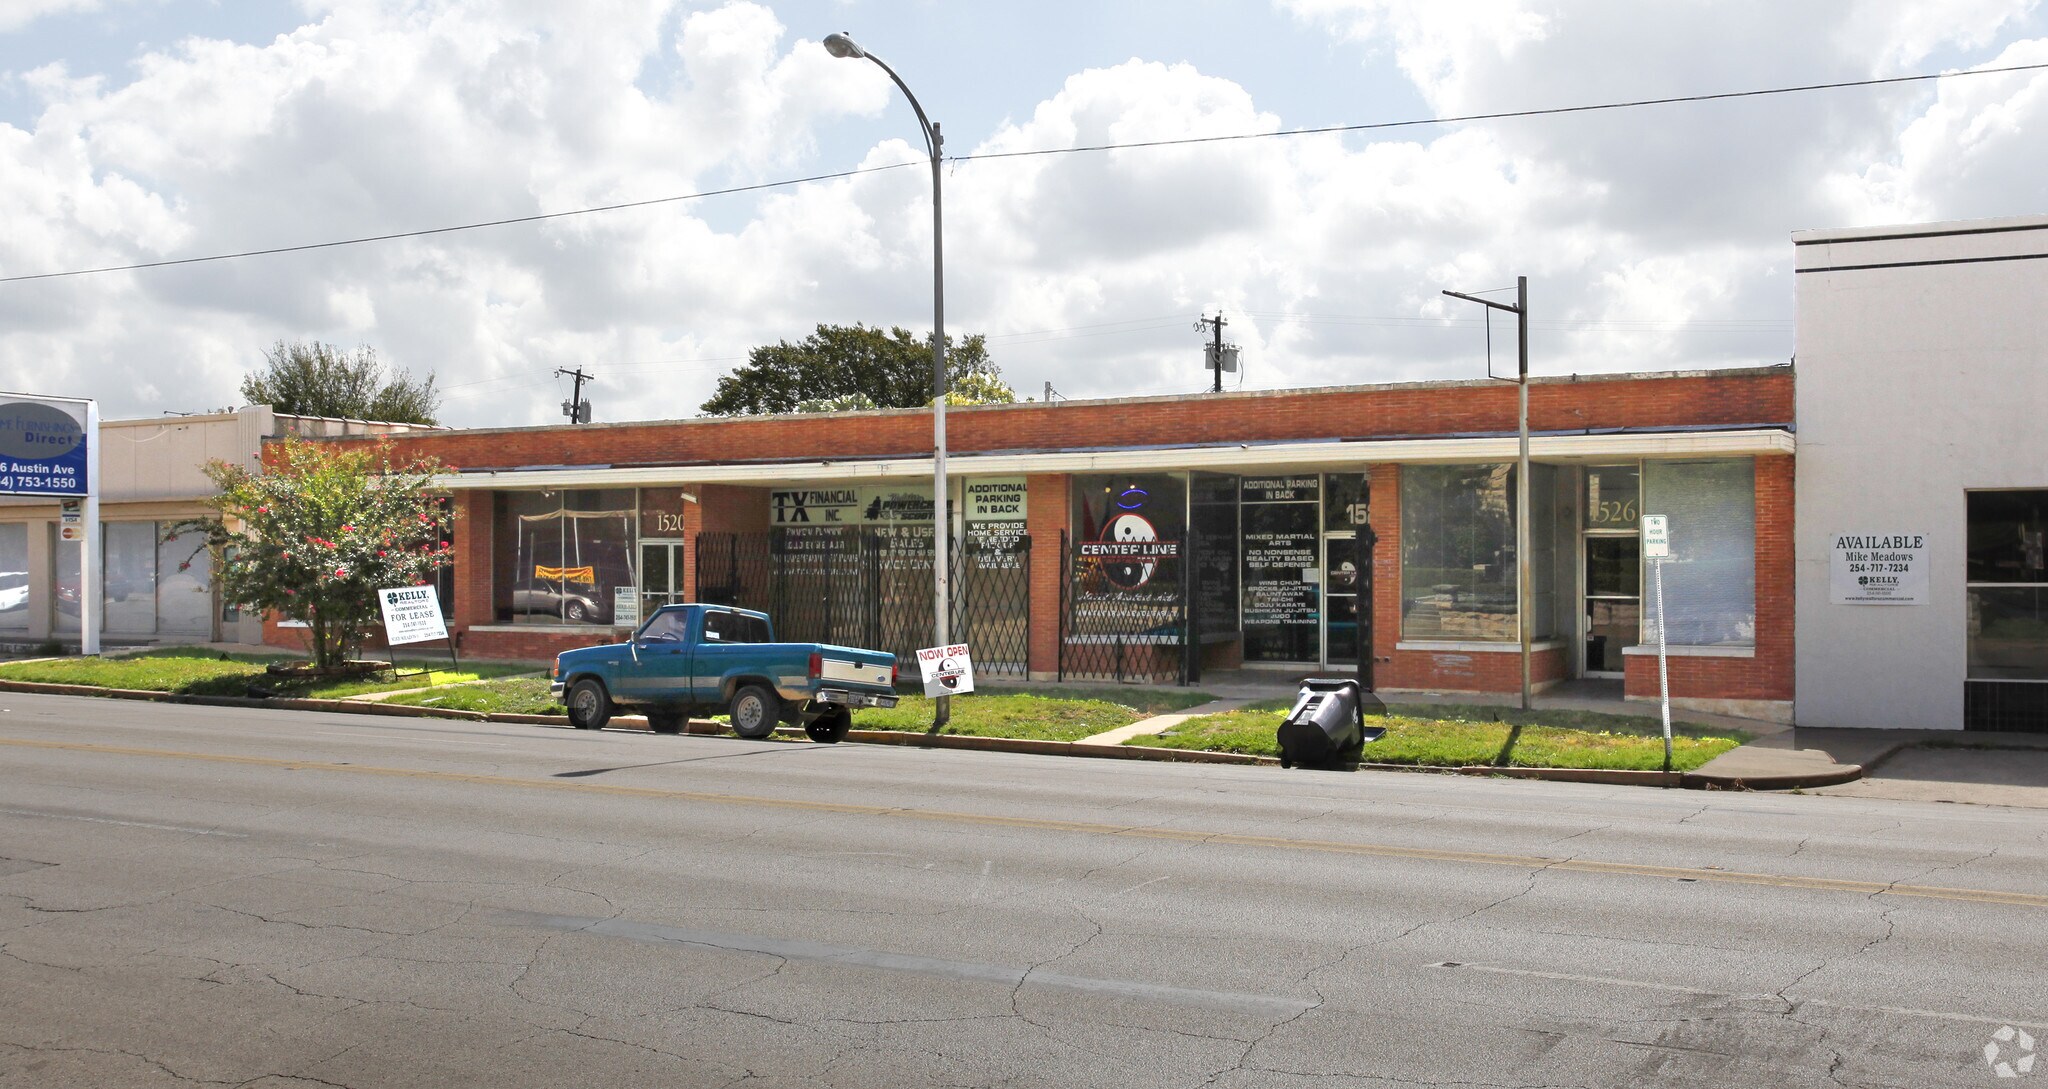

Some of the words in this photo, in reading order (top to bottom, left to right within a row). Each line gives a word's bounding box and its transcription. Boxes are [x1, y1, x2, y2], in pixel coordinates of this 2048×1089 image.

[25, 431, 73, 445] Direct
[11, 463, 49, 473] Austin
[53, 464, 75, 475] Ave
[0, 475, 14, 489] 4)
[17, 476, 76, 489] 753-1550
[1243, 480, 1284, 489] ADDITIONAL
[1286, 479, 1318, 489] PARKING
[968, 484, 1027, 494] ADDITIONAL
[1265, 491, 1273, 499] IN
[1275, 490, 1295, 499] BACK
[809, 490, 857, 504] FINANCIAL
[975, 494, 1021, 503] PARKING
[772, 491, 810, 522] TX
[977, 505, 987, 513] IN
[991, 505, 1019, 513] BACK
[1345, 503, 1370, 525] 15
[657, 514, 684, 532] 1520
[988, 522, 1025, 530] PROVIDE
[901, 526, 910, 538] &
[913, 526, 935, 538] USE
[1836, 535, 1923, 549] AVAILABLE
[1143, 544, 1177, 555] LINE
[1845, 551, 1869, 561] Mike
[1871, 551, 1913, 561] Meadows
[391, 613, 407, 622] FOR
[409, 610, 435, 620] LEASE
[919, 649, 944, 661] NOW
[947, 645, 969, 657] OPEN
